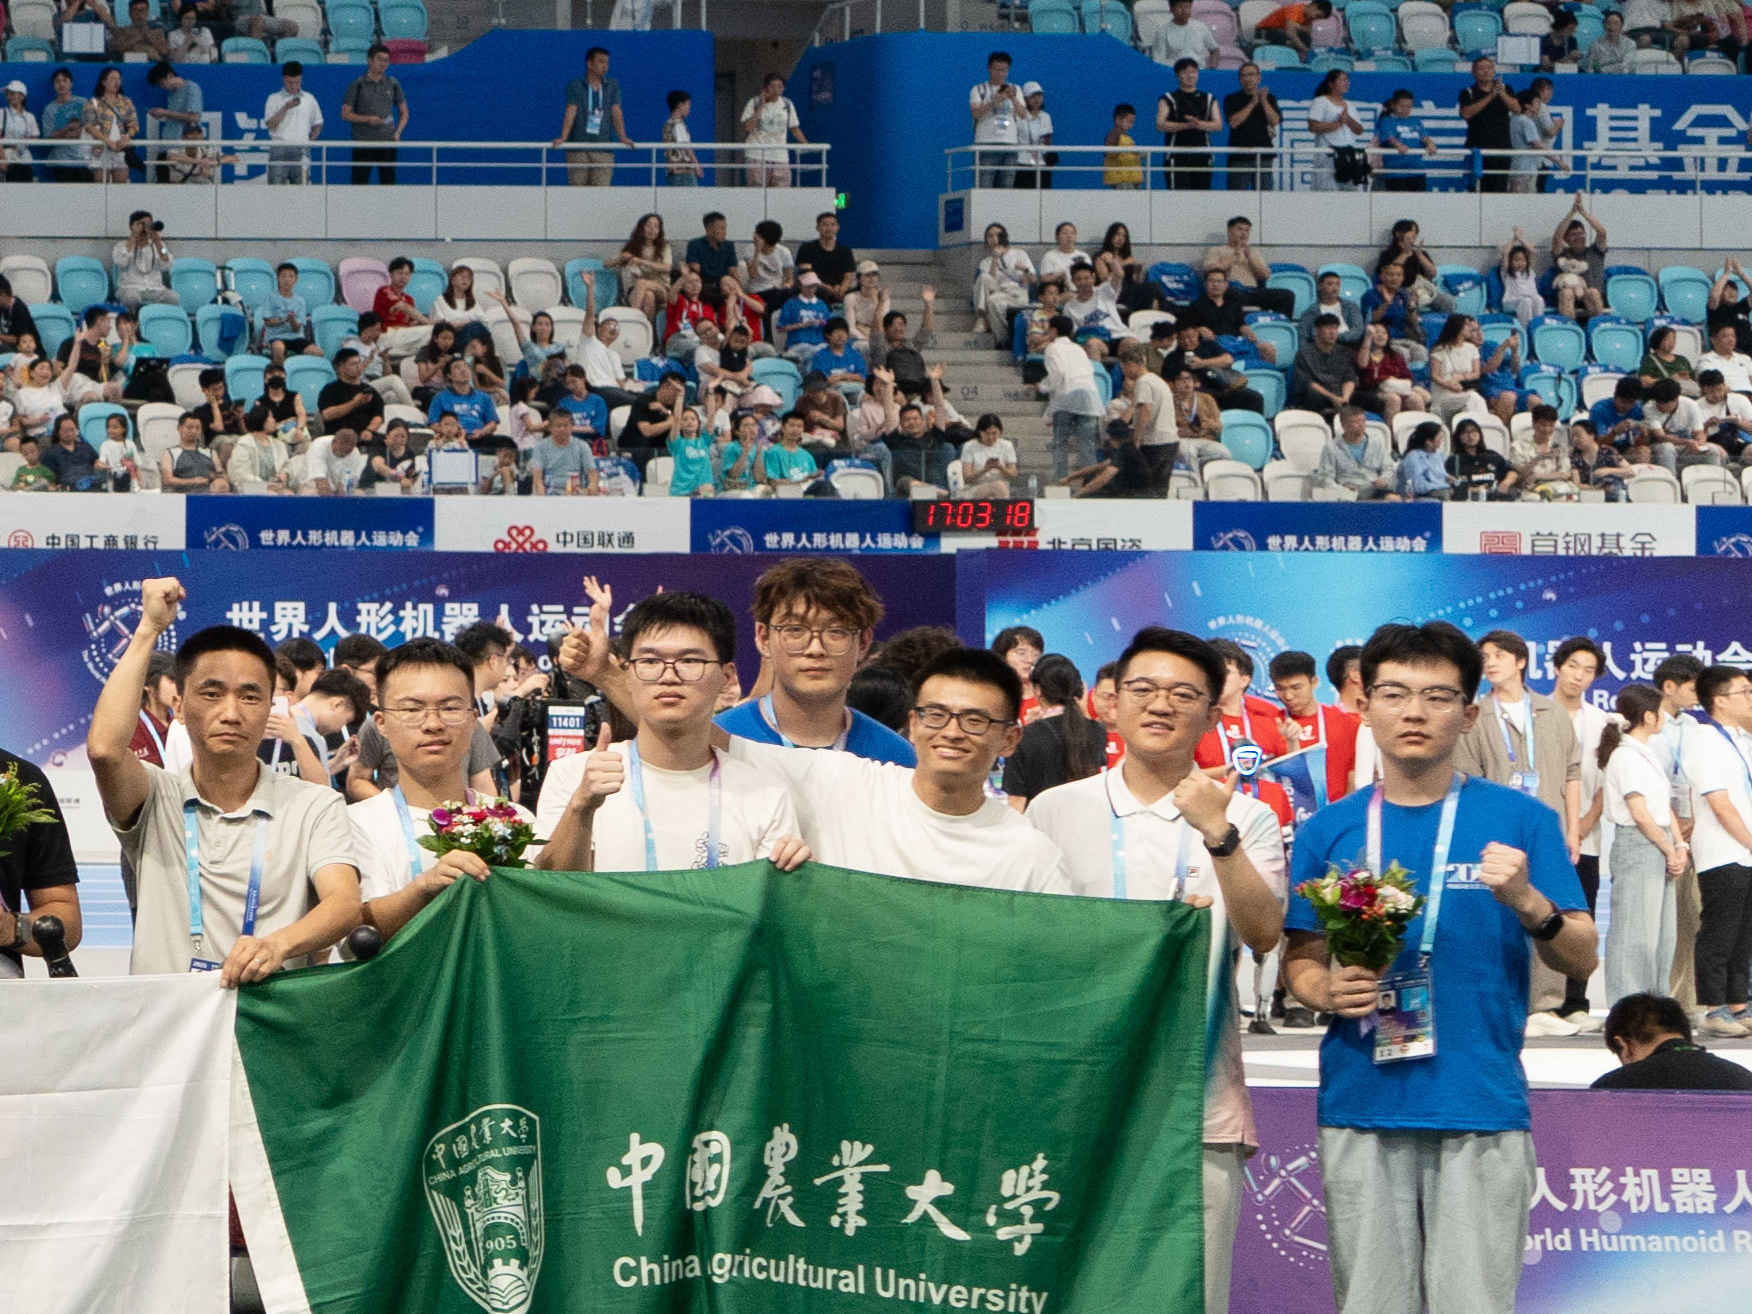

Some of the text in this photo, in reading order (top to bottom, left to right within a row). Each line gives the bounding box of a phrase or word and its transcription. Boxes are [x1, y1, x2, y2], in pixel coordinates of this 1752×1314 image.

[926, 501, 1032, 527] 17:03:18
[259, 529, 421, 546] 世界人形机器人运动会
[555, 530, 636, 550] 中国联通
[764, 532, 926, 549] 世界人形机器人运动会
[551, 717, 581, 728] 11401
[1523, 1228, 1572, 1253] orld
[1580, 1228, 1726, 1254] Humanoid
[613, 1254, 701, 1288] China
[707, 1248, 865, 1295] gricultural
